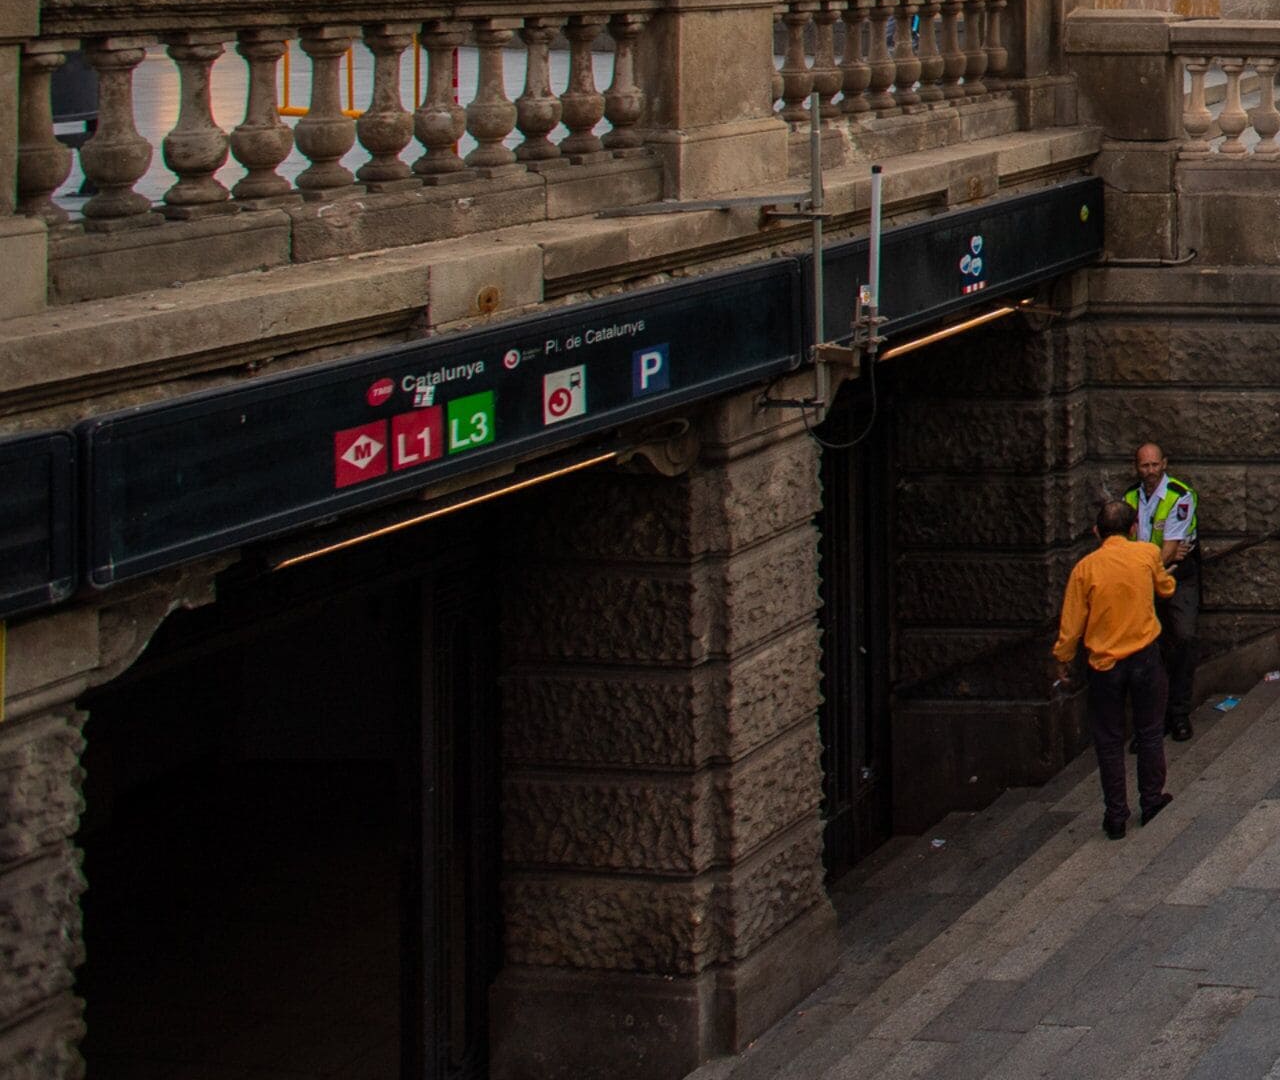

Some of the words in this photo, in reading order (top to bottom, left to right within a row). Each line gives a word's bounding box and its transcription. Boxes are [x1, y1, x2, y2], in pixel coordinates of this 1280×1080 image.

[545, 339, 561, 354] Pl.
[566, 335, 581, 349] de
[585, 320, 645, 344] Catalunya
[402, 360, 484, 391] Catalunya
[640, 352, 662, 389] P
[354, 441, 373, 461] M
[397, 427, 432, 465] L1
[452, 412, 488, 449] L3
